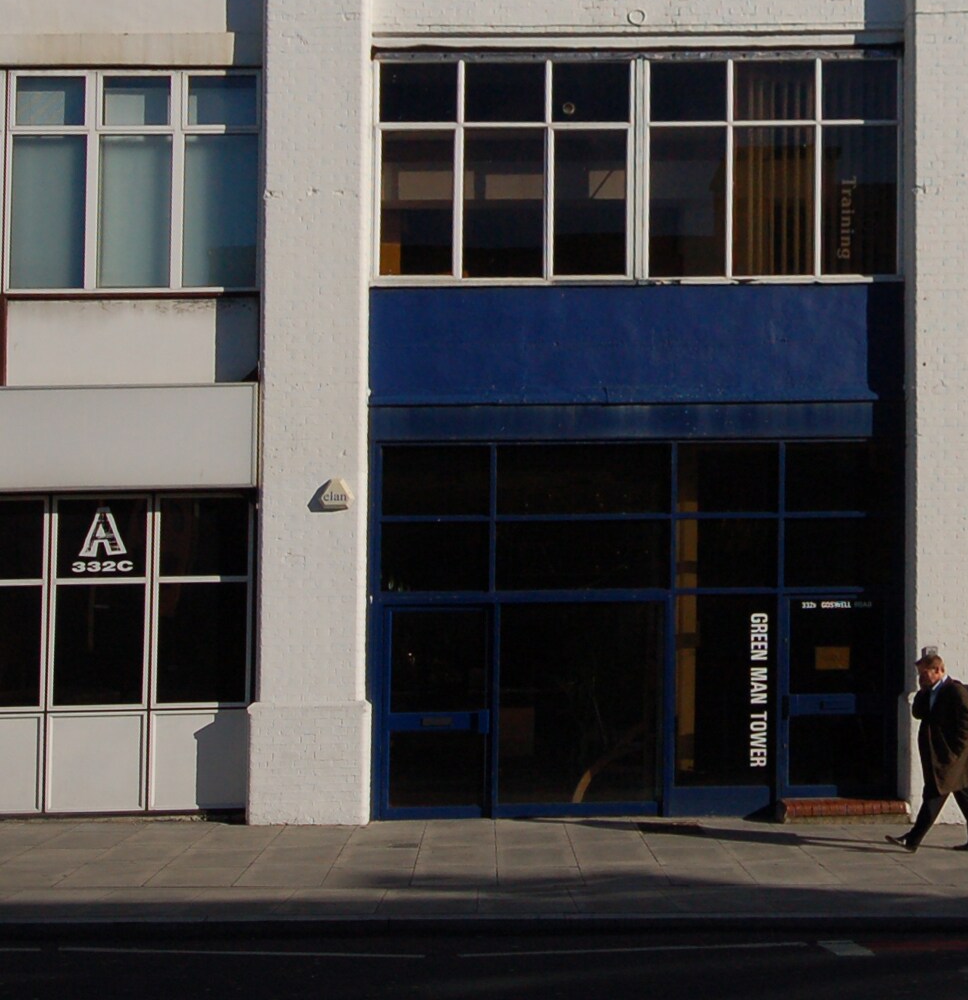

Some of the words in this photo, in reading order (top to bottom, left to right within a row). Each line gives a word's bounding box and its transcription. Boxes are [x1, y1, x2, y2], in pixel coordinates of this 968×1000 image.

[837, 175, 857, 260] Training
[72, 560, 133, 573] 332C
[821, 601, 852, 609] GOSWELL
[750, 612, 769, 661] GREEN
[749, 667, 768, 704] MAN
[749, 711, 768, 767] TOWER
